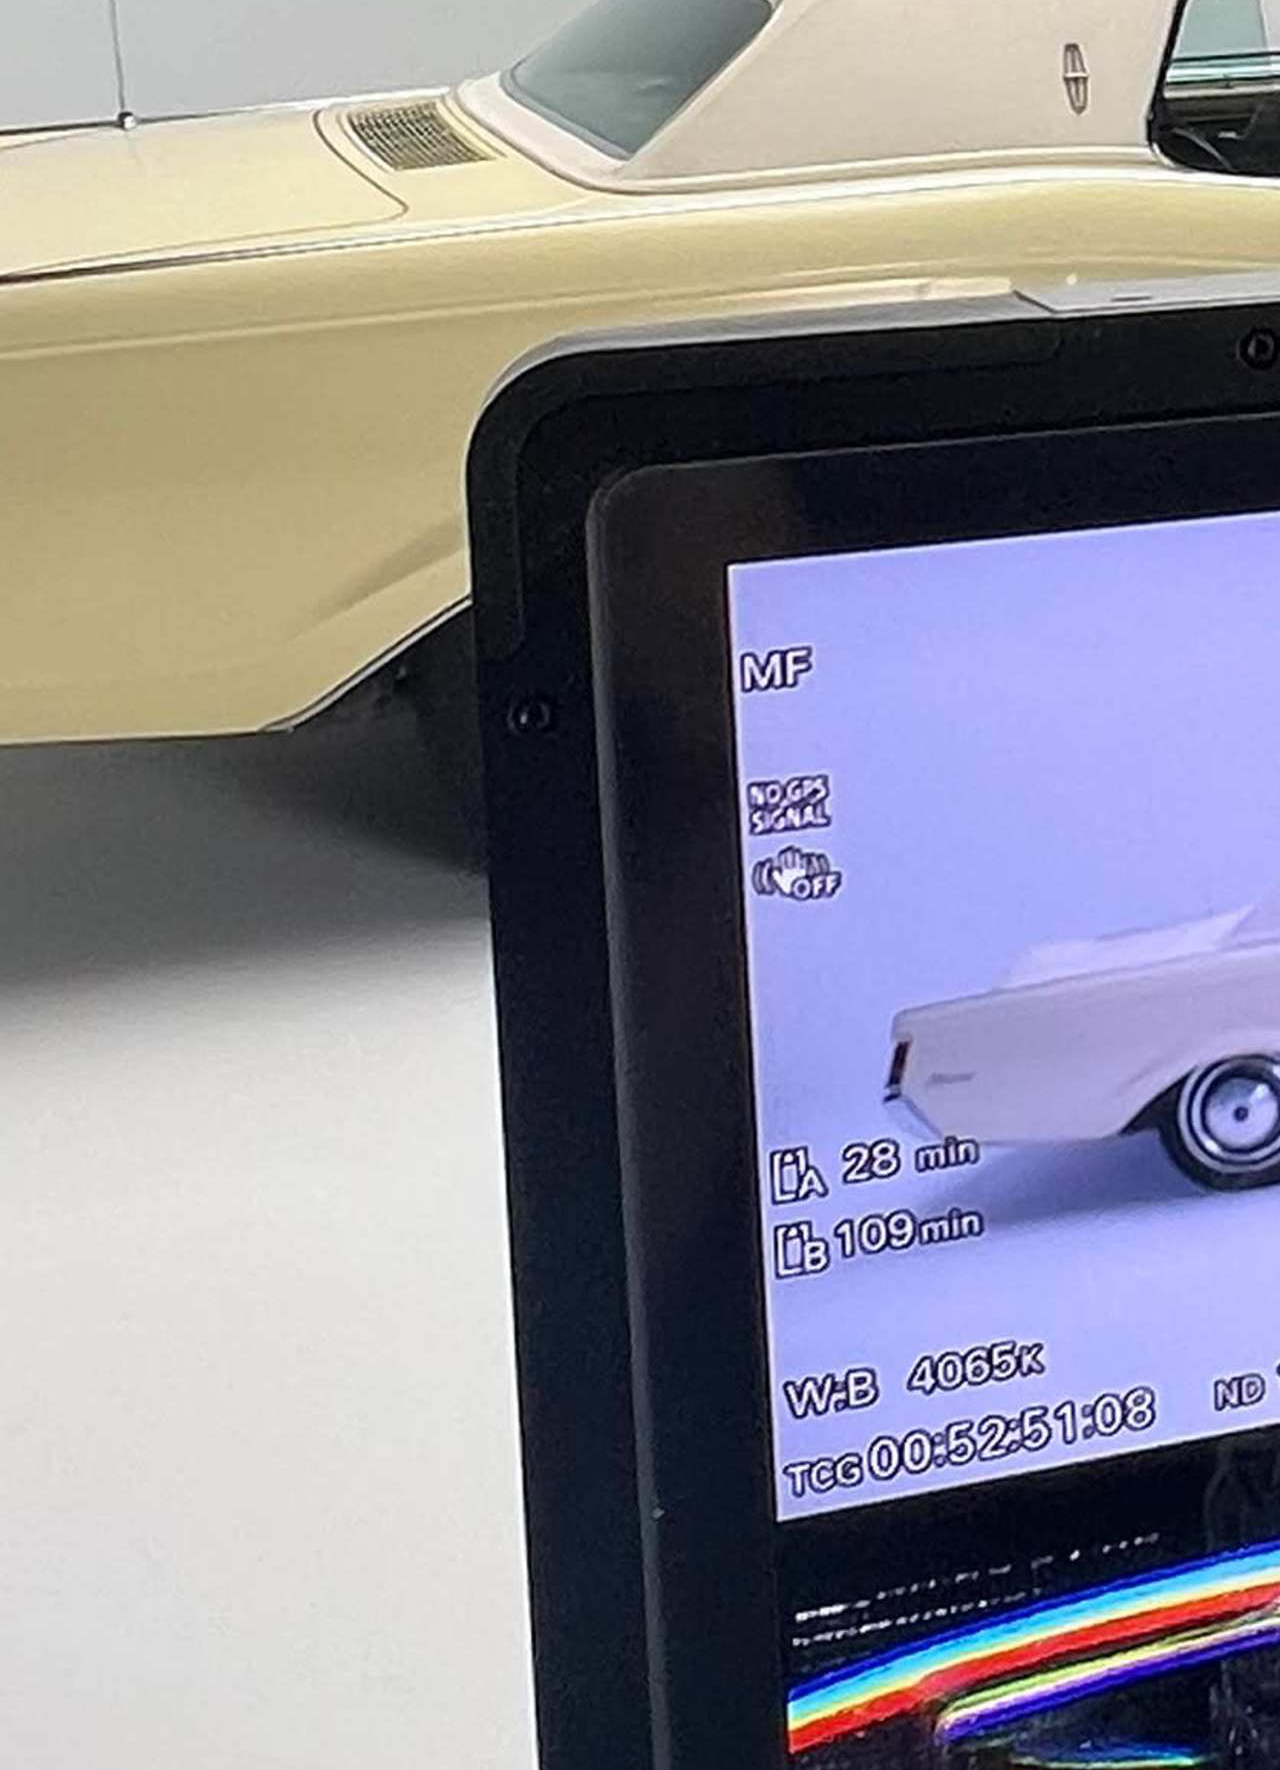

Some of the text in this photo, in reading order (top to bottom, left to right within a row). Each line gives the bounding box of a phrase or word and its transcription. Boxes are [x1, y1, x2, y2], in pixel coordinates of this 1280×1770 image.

[741, 647, 812, 692] MF
[793, 871, 842, 900] OFF
[841, 1137, 901, 1185] 28
[915, 1135, 980, 1173] min
[834, 1208, 916, 1256] 109
[918, 1207, 984, 1246] min
[906, 1338, 1047, 1397] 4065K
[1214, 1372, 1266, 1413] ND
